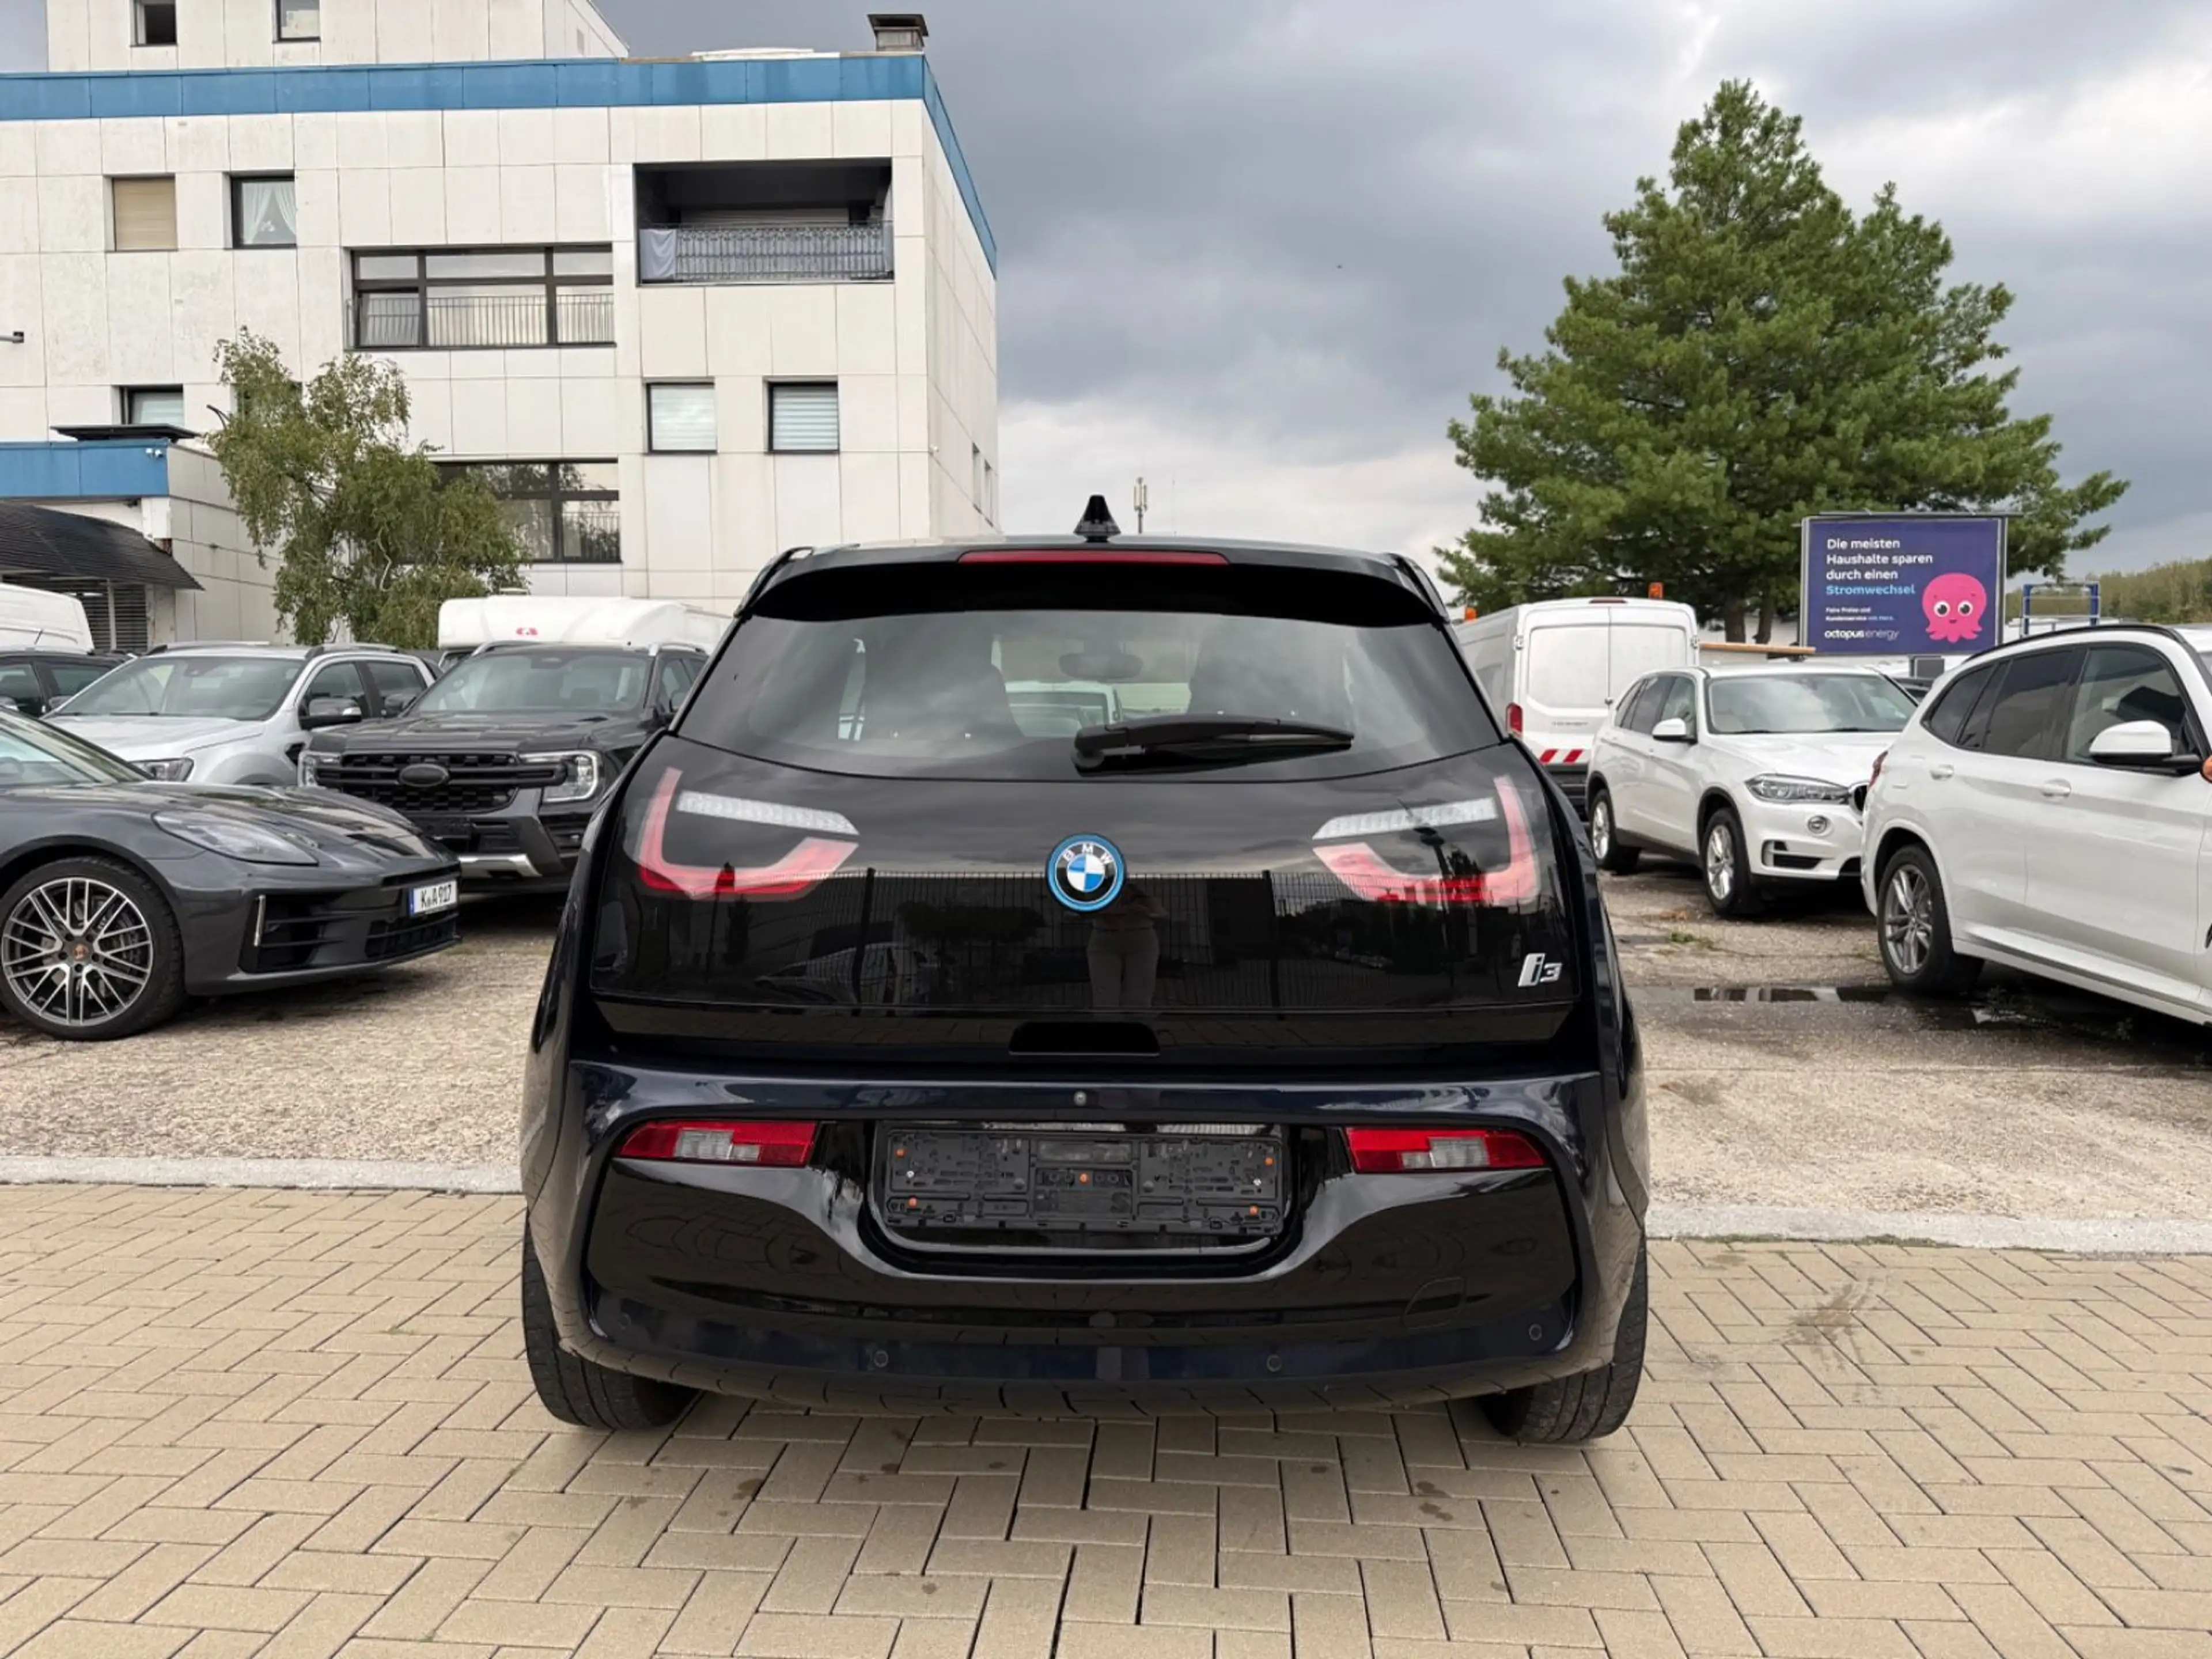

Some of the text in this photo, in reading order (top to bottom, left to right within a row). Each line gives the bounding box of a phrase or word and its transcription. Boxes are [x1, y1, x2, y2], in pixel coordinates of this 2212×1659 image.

[1827, 538, 1900, 550] Die meisten
[1826, 554, 1933, 567] Haushalte sparen
[1825, 569, 1899, 580] durch einen
[1825, 584, 1916, 596] Stromwechsel
[1062, 842, 1113, 865] BMW
